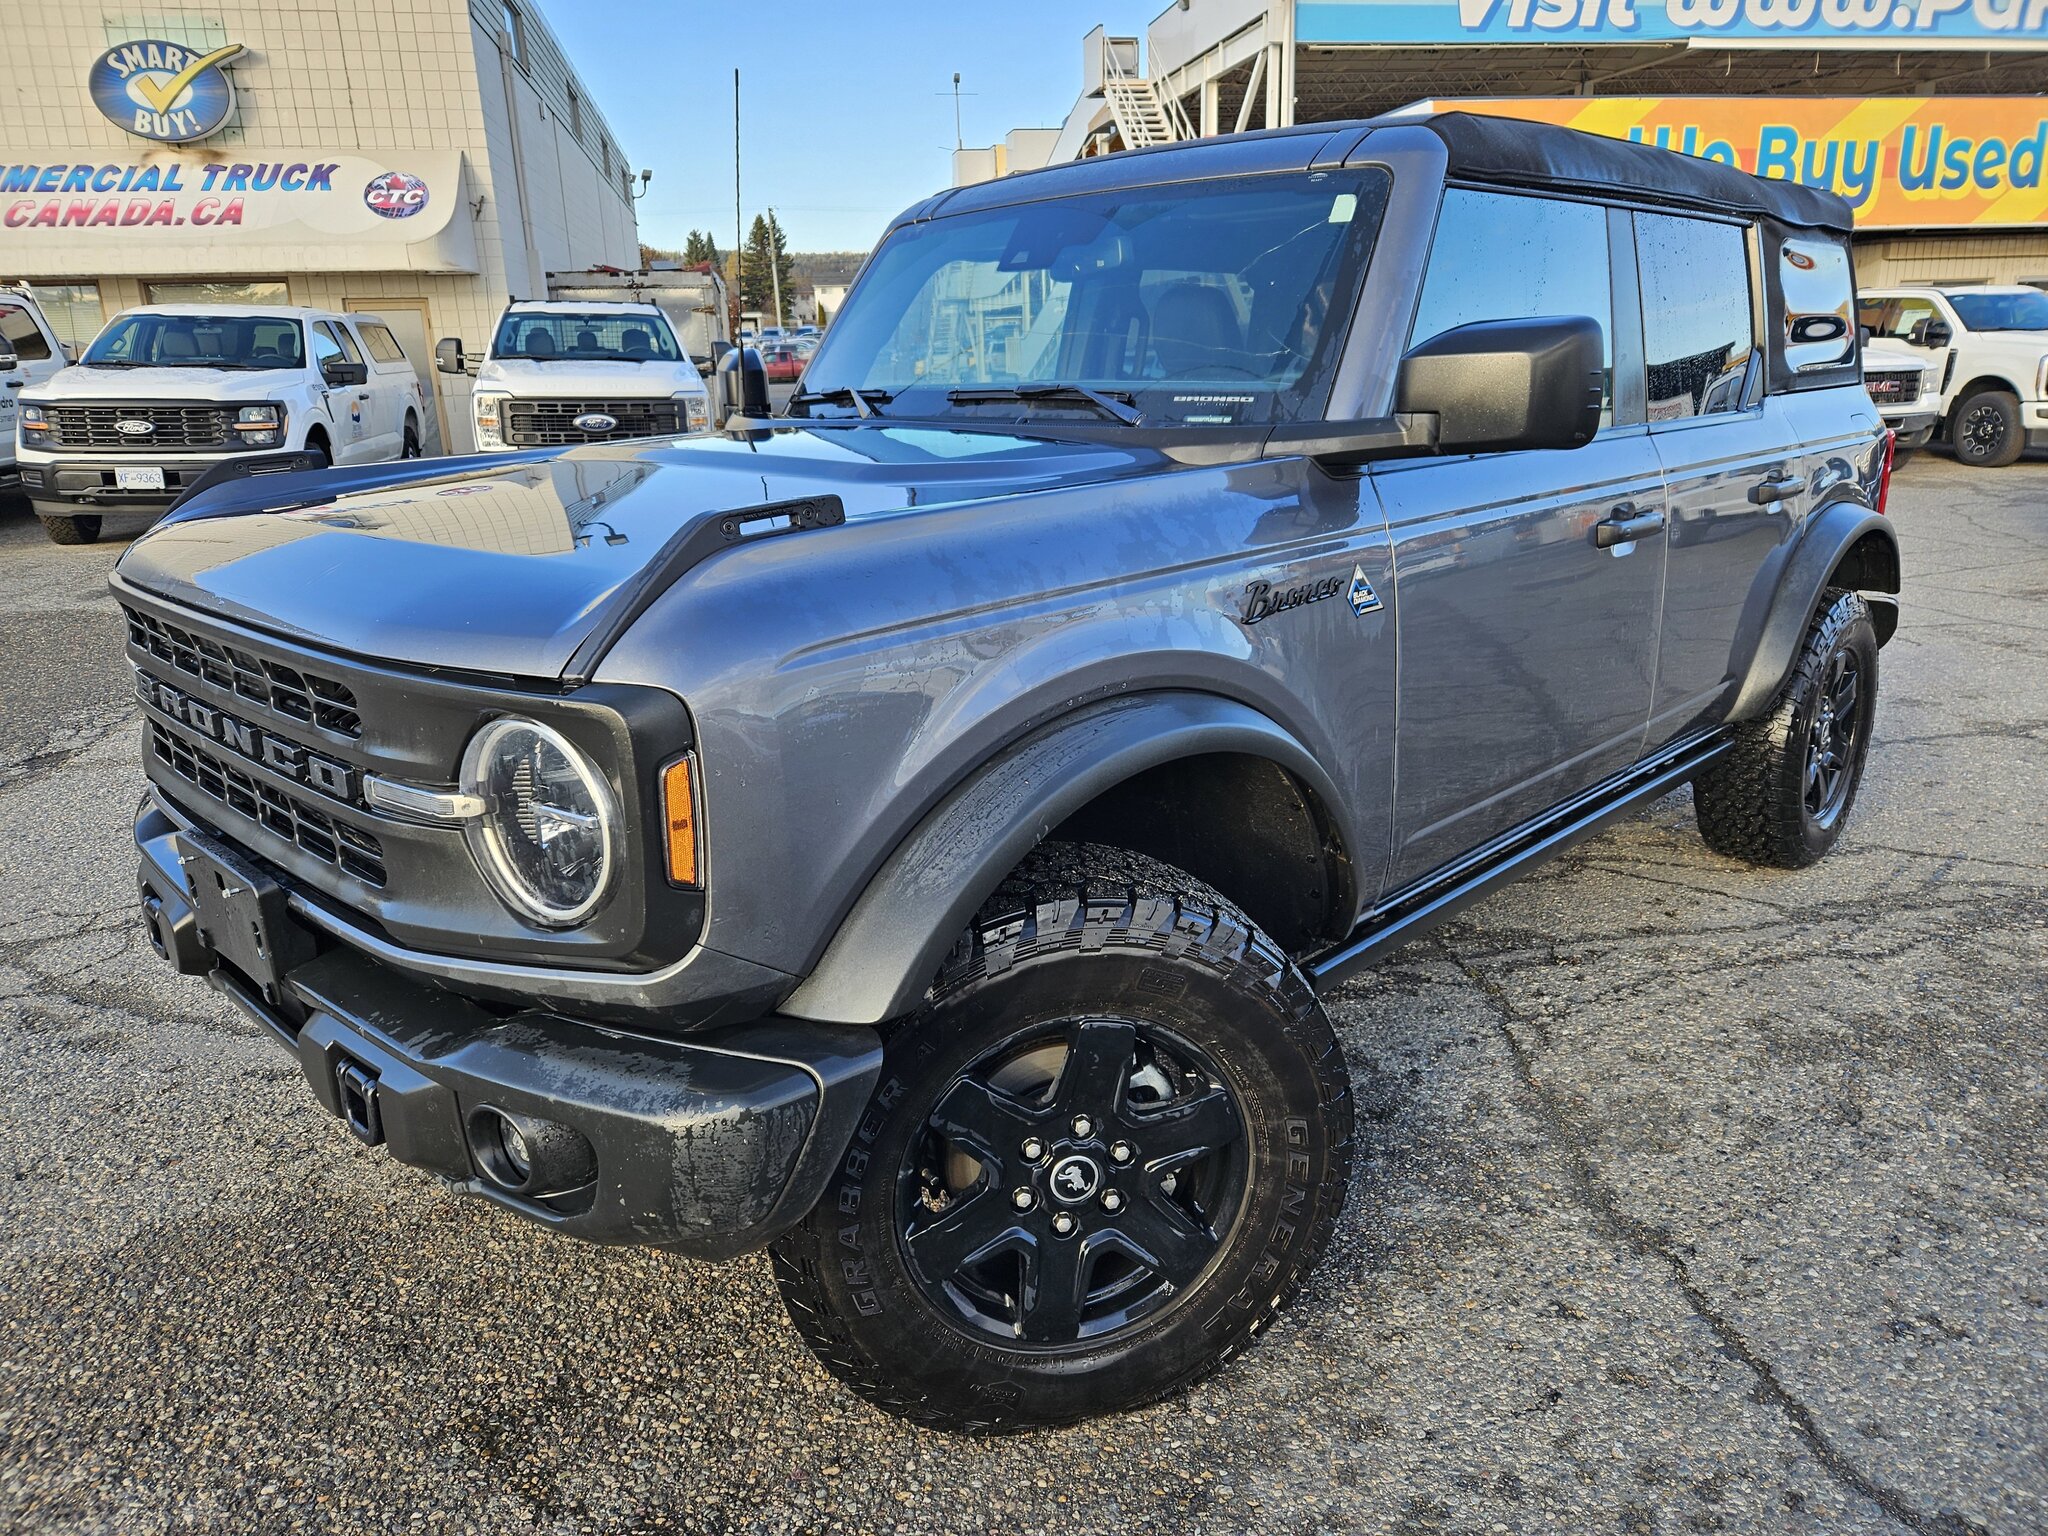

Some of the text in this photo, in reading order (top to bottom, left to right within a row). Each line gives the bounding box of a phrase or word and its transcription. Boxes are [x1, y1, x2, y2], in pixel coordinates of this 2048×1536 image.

[134, 108, 201, 137] BUY!
[0, 163, 341, 192] MERCIAL TRUCK
[1899, 118, 2048, 192] Used
[3, 197, 245, 228] CANADA.CA
[367, 189, 424, 204] CTC
[1240, 576, 1345, 625] Bronco
[135, 667, 358, 801] BRONCO
[838, 1075, 908, 1318] GRABBER
[1201, 1116, 1311, 1333] GENERAL
